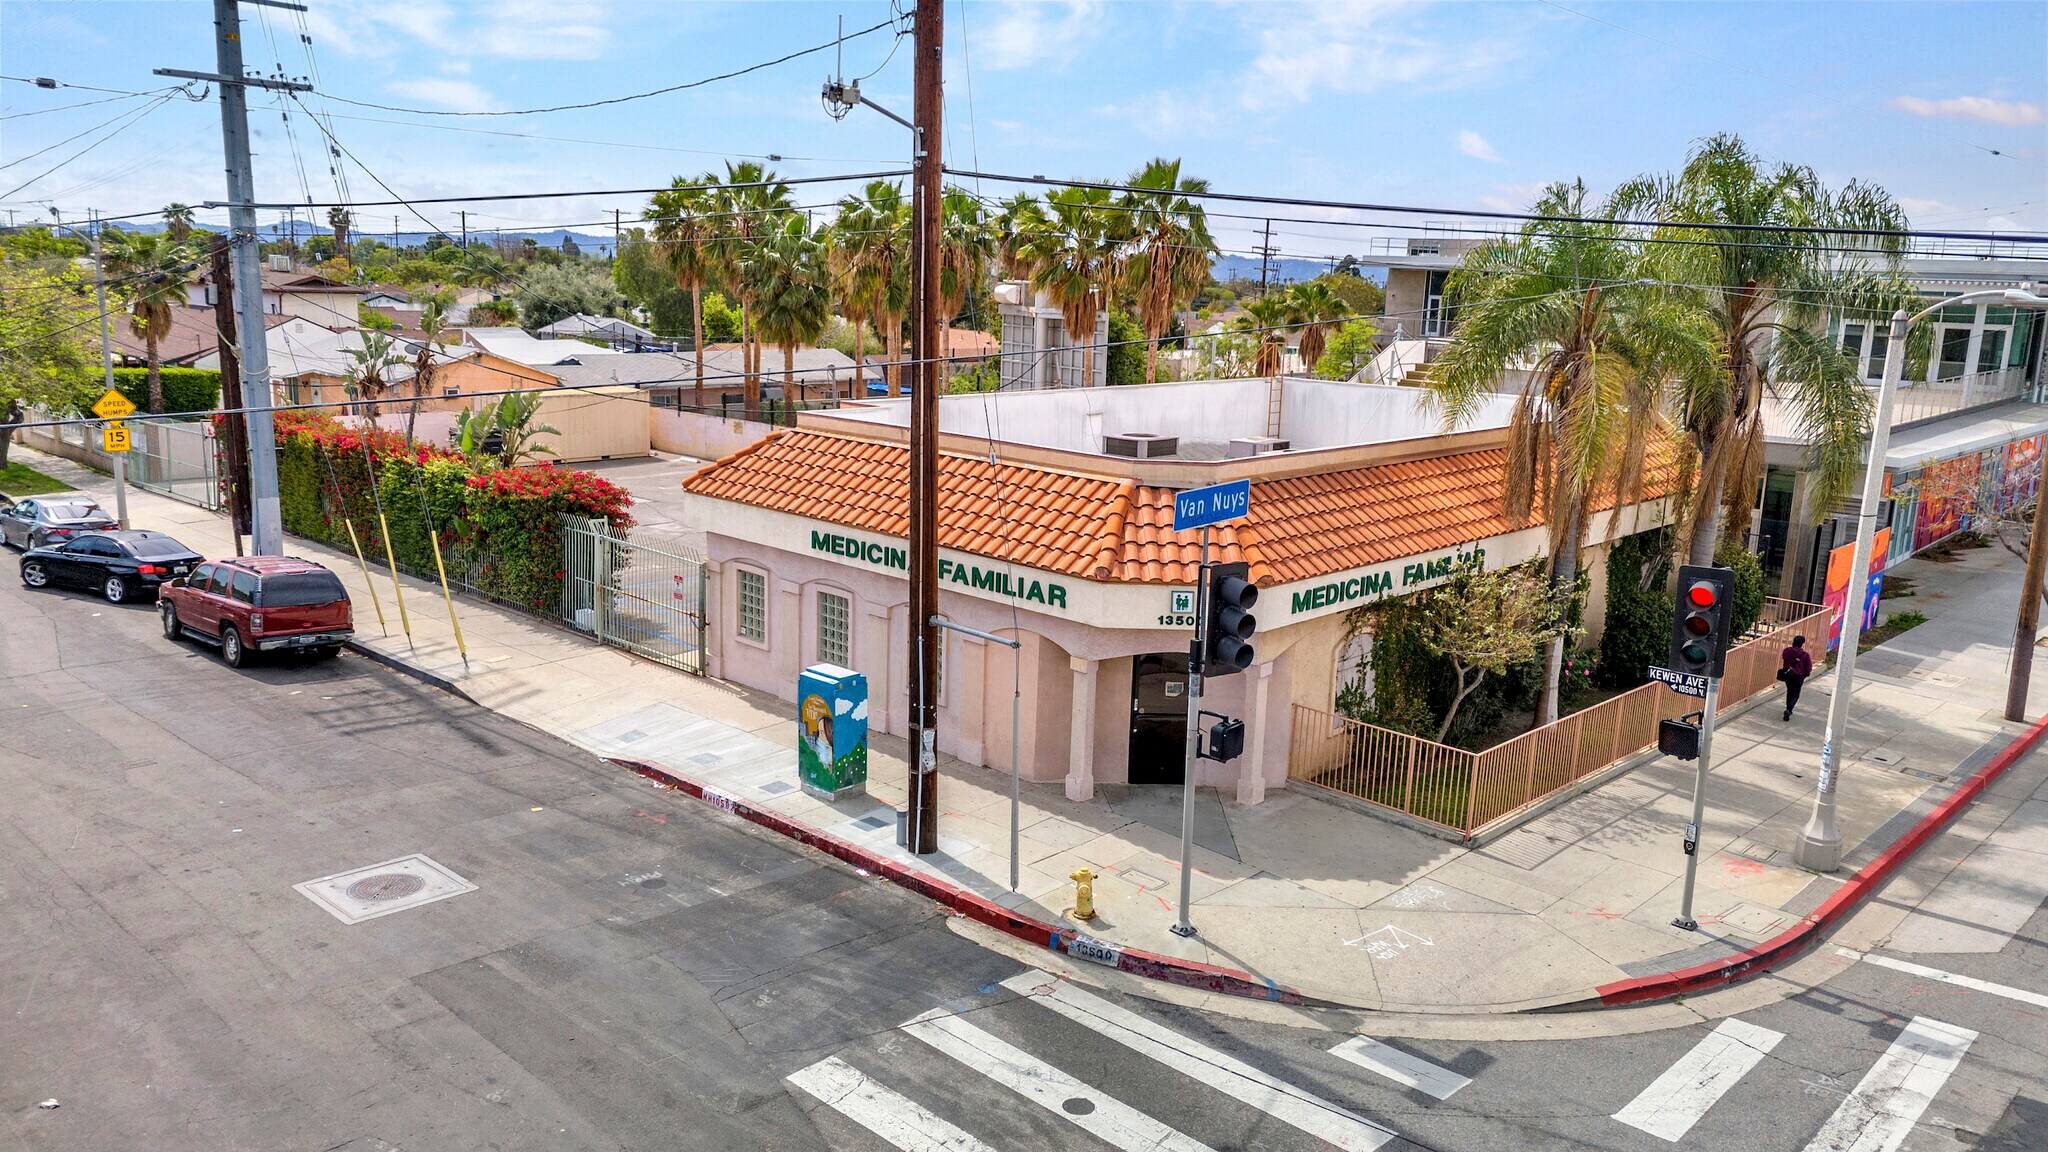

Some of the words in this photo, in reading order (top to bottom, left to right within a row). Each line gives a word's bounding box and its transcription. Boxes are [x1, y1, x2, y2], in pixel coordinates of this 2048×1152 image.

[109, 431, 125, 442] 15
[1180, 499, 1205, 518] Van
[1212, 491, 1245, 513] Nuys
[811, 530, 911, 574] MEDICIN
[937, 559, 1067, 608] FAMILIAR
[1291, 571, 1393, 614] MEDICINA
[1157, 615, 1200, 626] 1350
[1650, 668, 1683, 684] KEWEN
